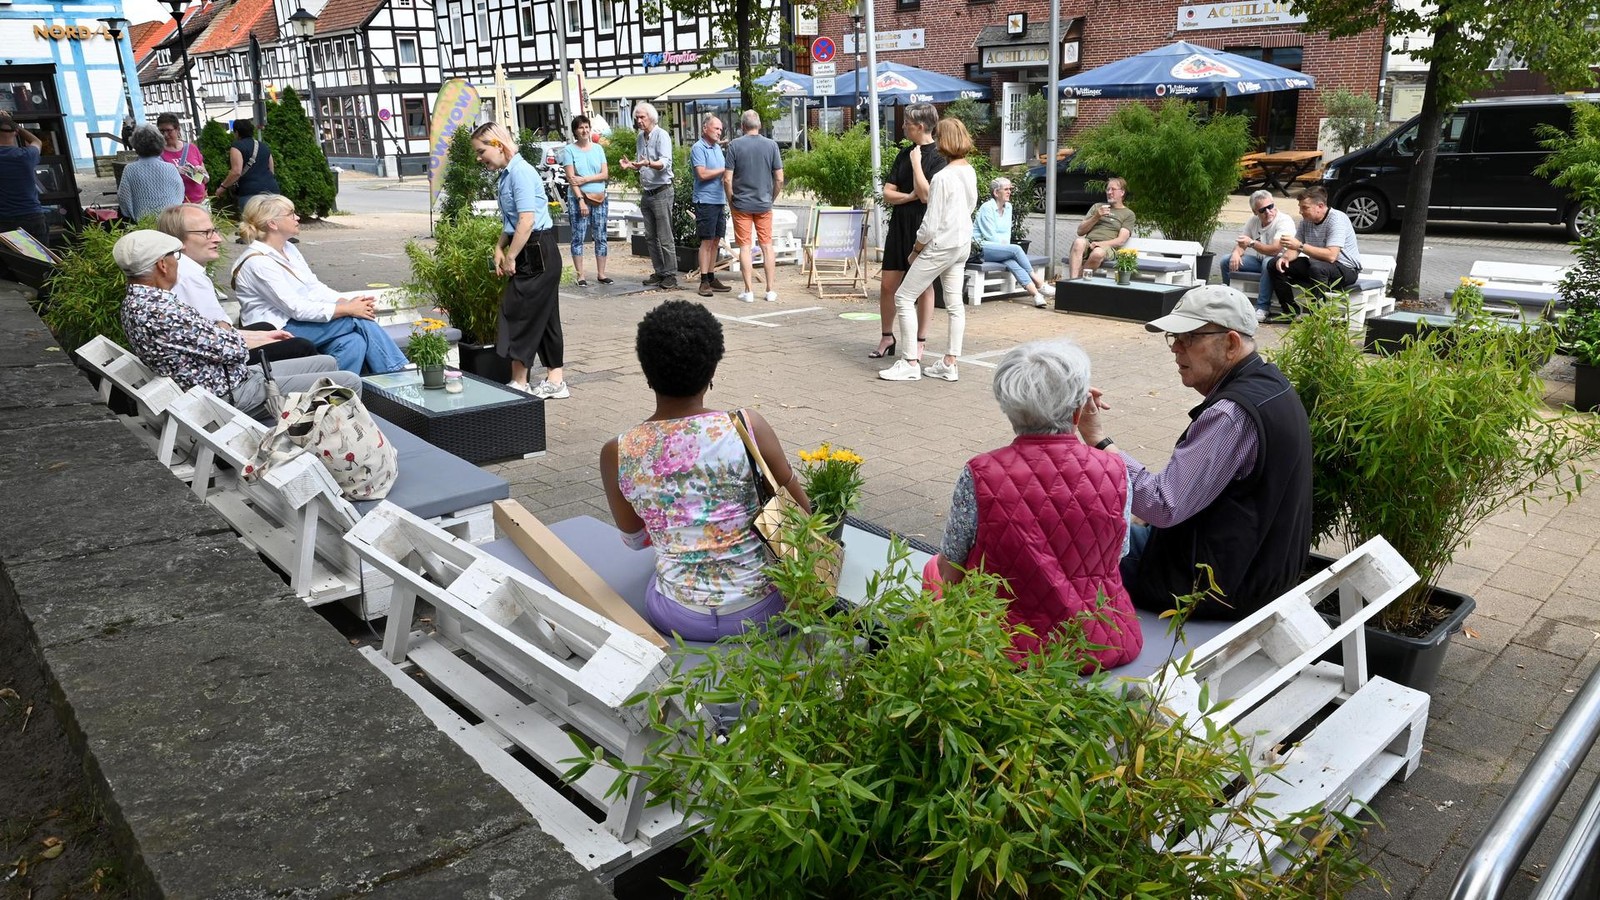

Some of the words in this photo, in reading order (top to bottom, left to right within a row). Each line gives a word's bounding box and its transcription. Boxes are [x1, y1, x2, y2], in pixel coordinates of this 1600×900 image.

[1207, 3, 1291, 18] ACHILLIO
[987, 49, 1049, 63] ACHILLIO
[1074, 87, 1102, 96] Wittinger
[1167, 84, 1198, 95] Wittinger
